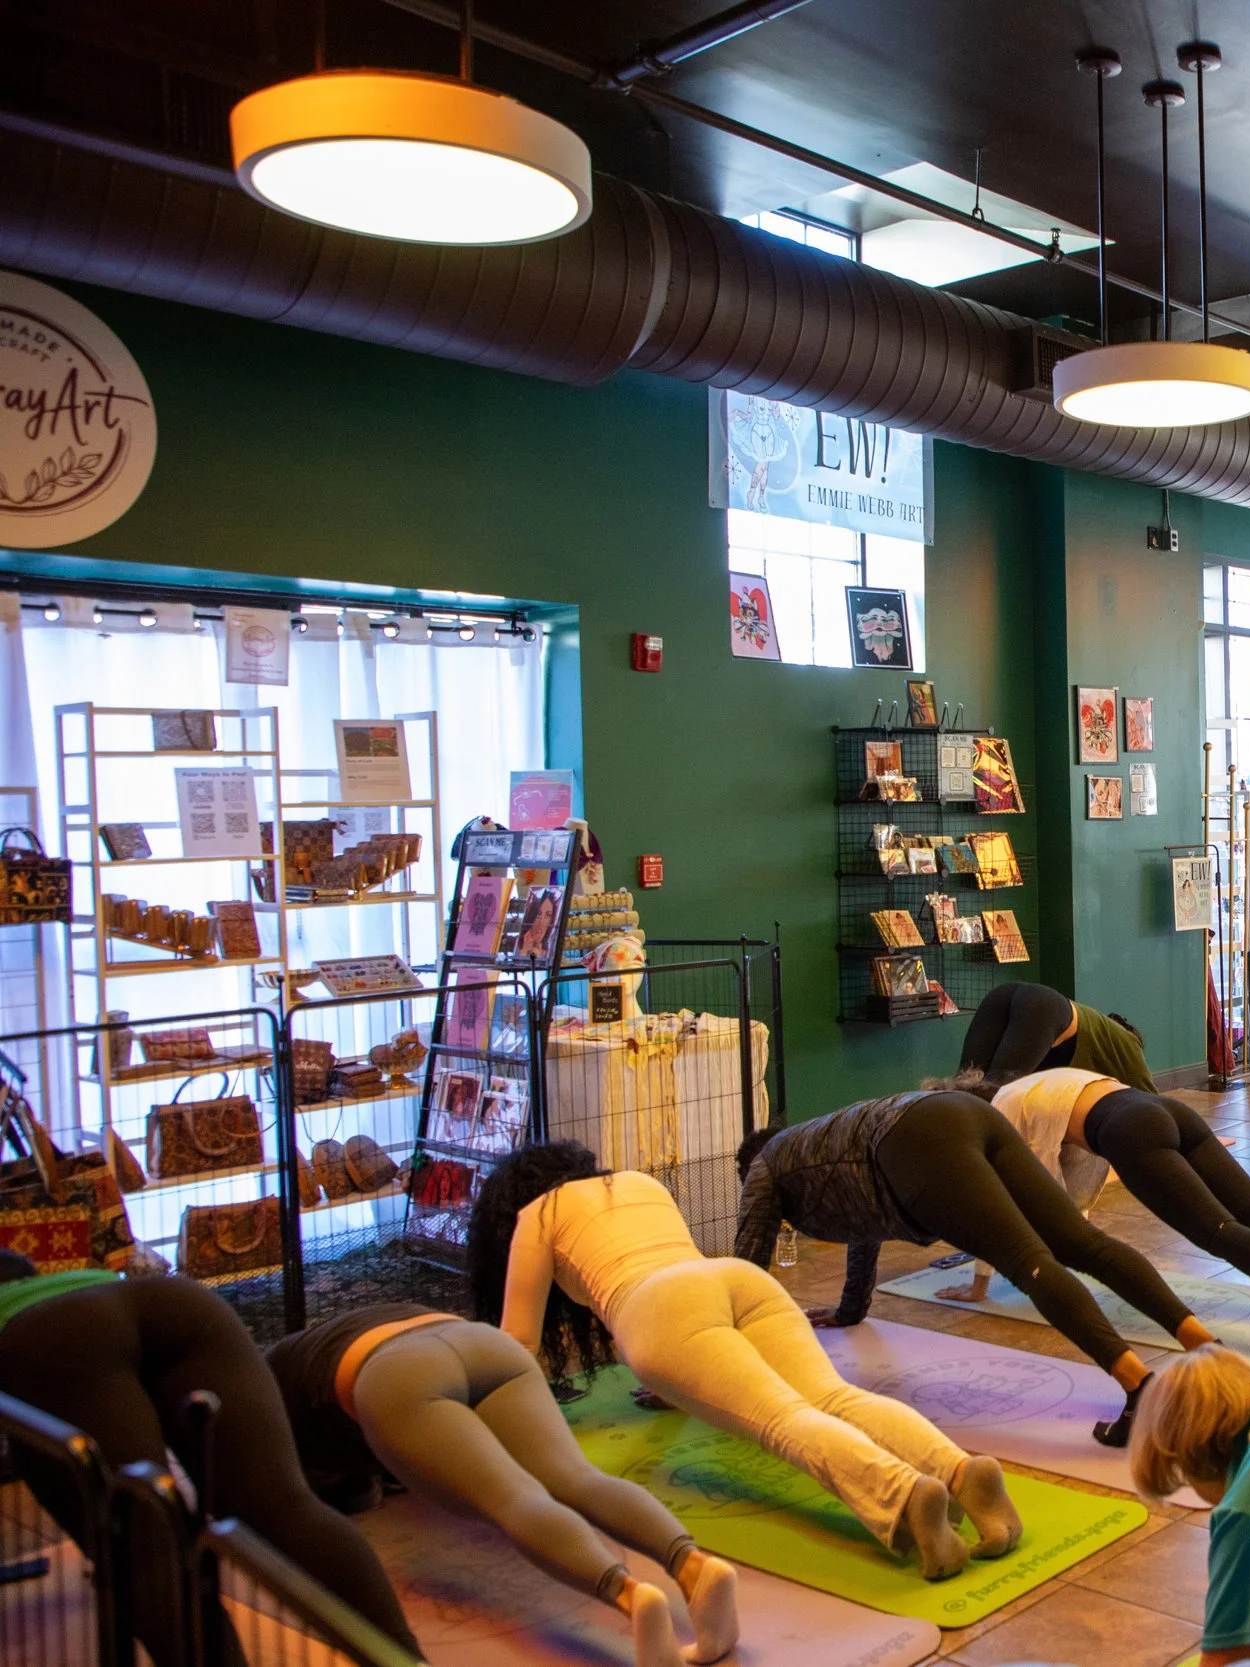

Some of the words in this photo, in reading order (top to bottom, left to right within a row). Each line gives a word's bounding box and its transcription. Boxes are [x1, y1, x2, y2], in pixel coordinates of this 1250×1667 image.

[0, 366, 149, 447] ayArt
[814, 409, 891, 484] EW!
[807, 483, 853, 511] EMMIE
[857, 494, 895, 518] WEBB
[898, 502, 925, 524] ART
[475, 836, 495, 848] SCAN
[1191, 860, 1211, 881] EW!
